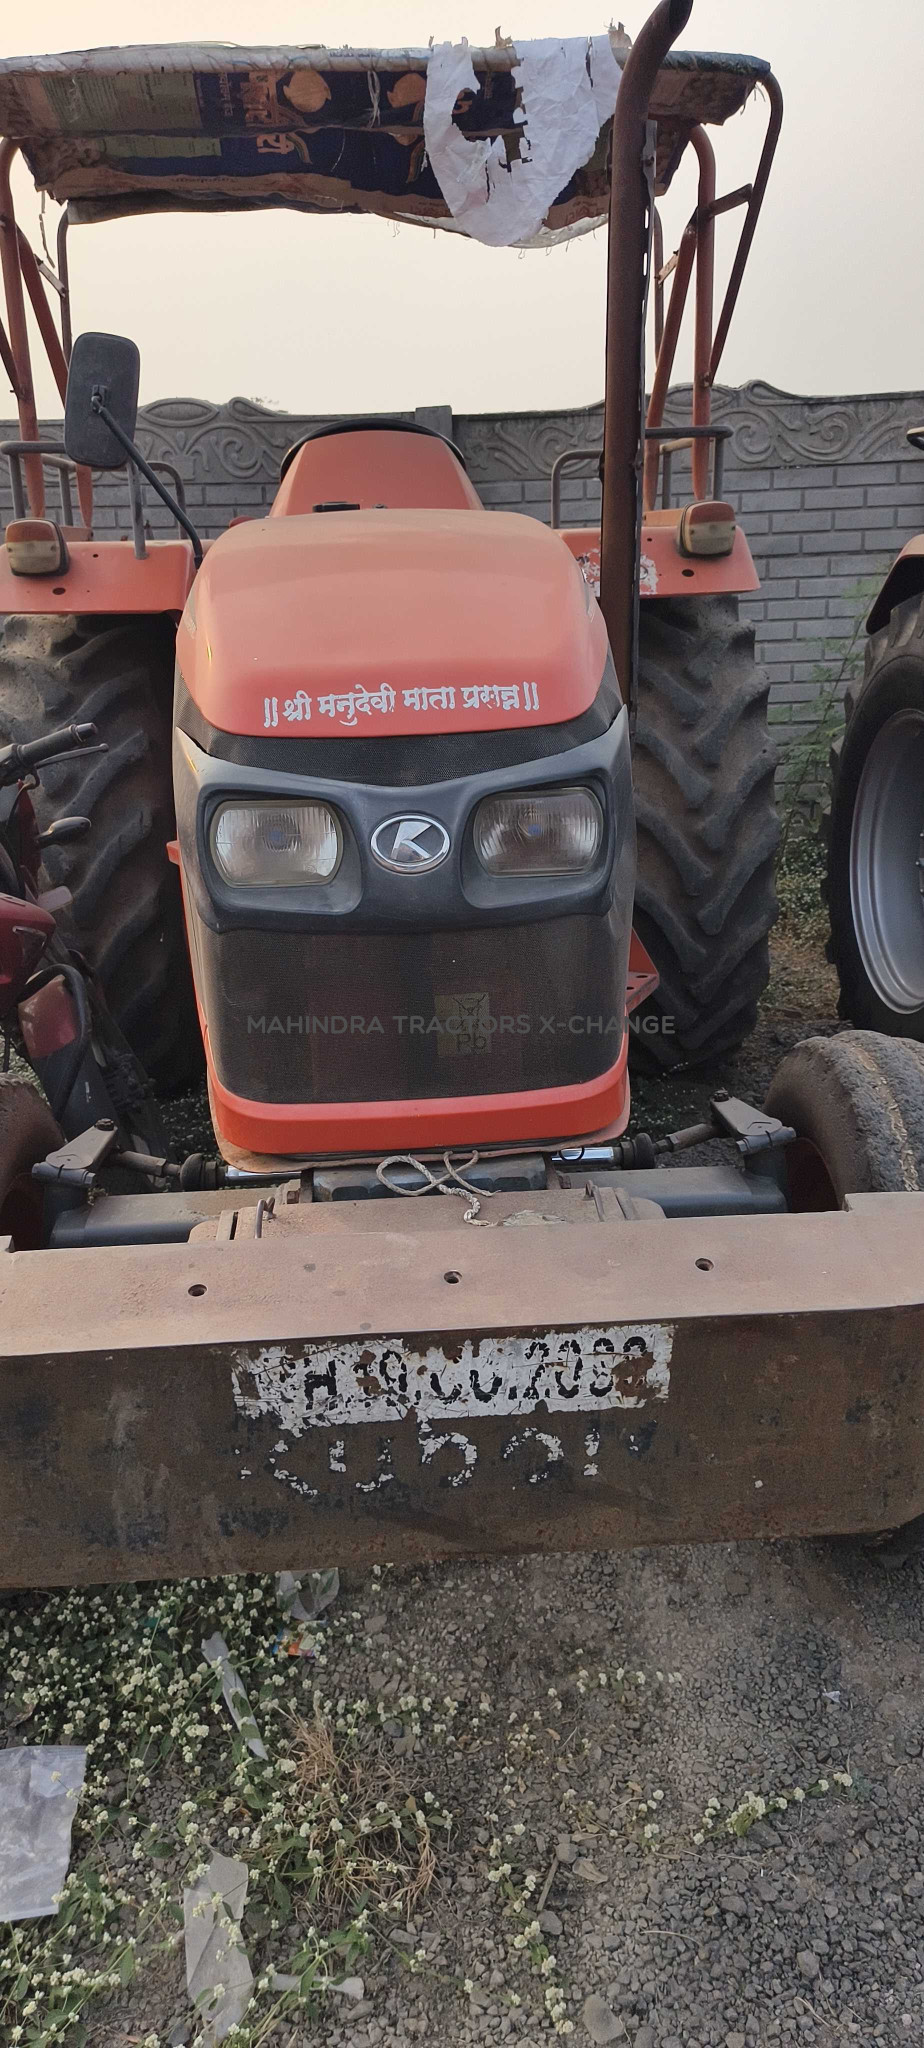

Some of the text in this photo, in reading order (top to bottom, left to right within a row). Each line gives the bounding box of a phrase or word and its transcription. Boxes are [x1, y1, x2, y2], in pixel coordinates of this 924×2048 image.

[317, 684, 396, 726] मनुदेवी
[402, 687, 456, 710] माता
[456, 1032, 487, 1051] Pb
